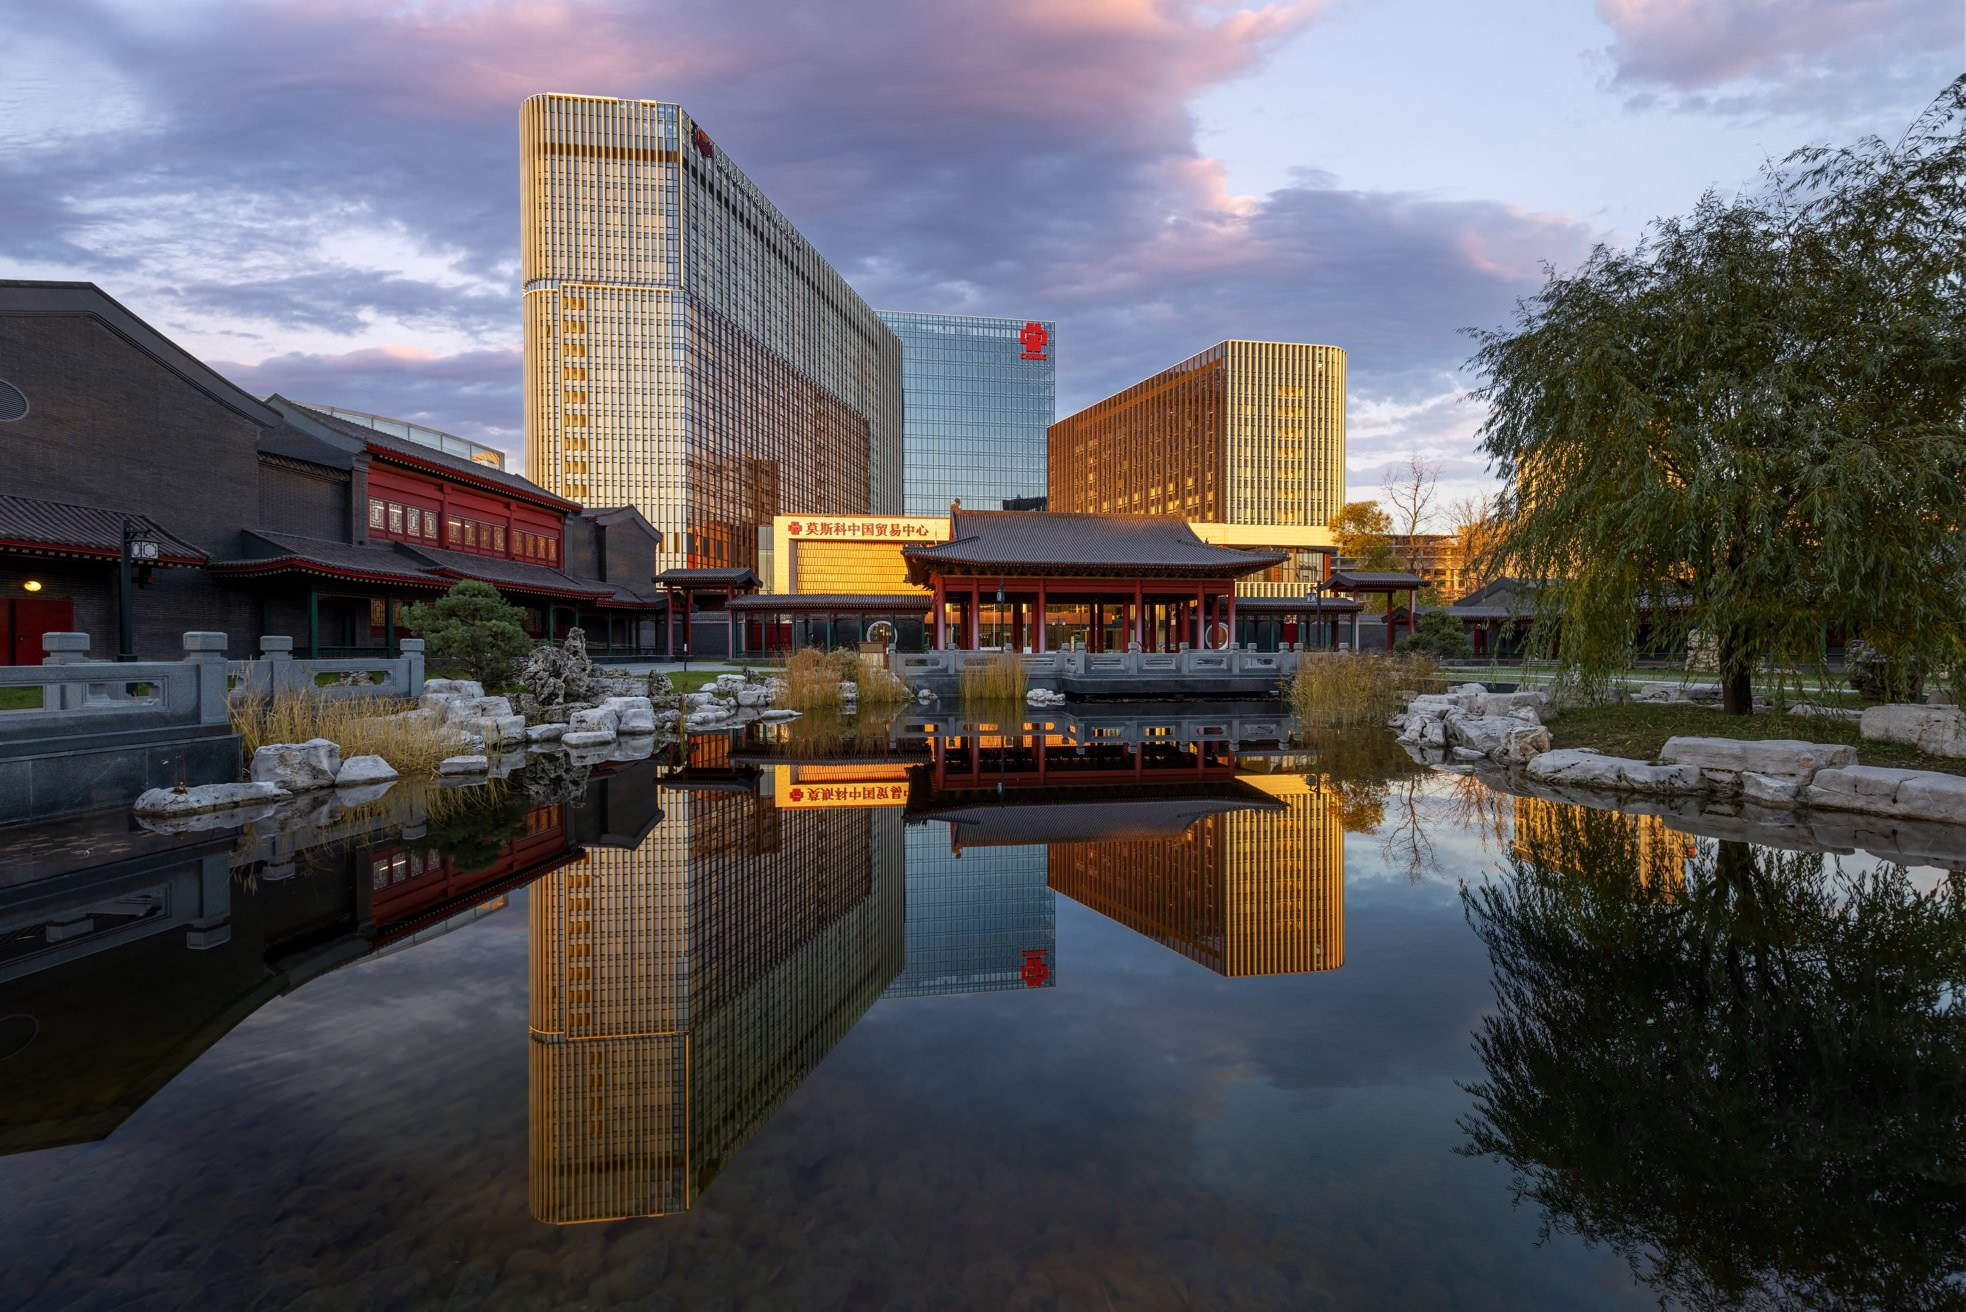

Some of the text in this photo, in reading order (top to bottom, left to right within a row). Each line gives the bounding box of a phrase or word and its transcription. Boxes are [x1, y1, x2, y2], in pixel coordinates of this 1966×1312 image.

[806, 522, 929, 536] 莫斯科中国贸易中心
